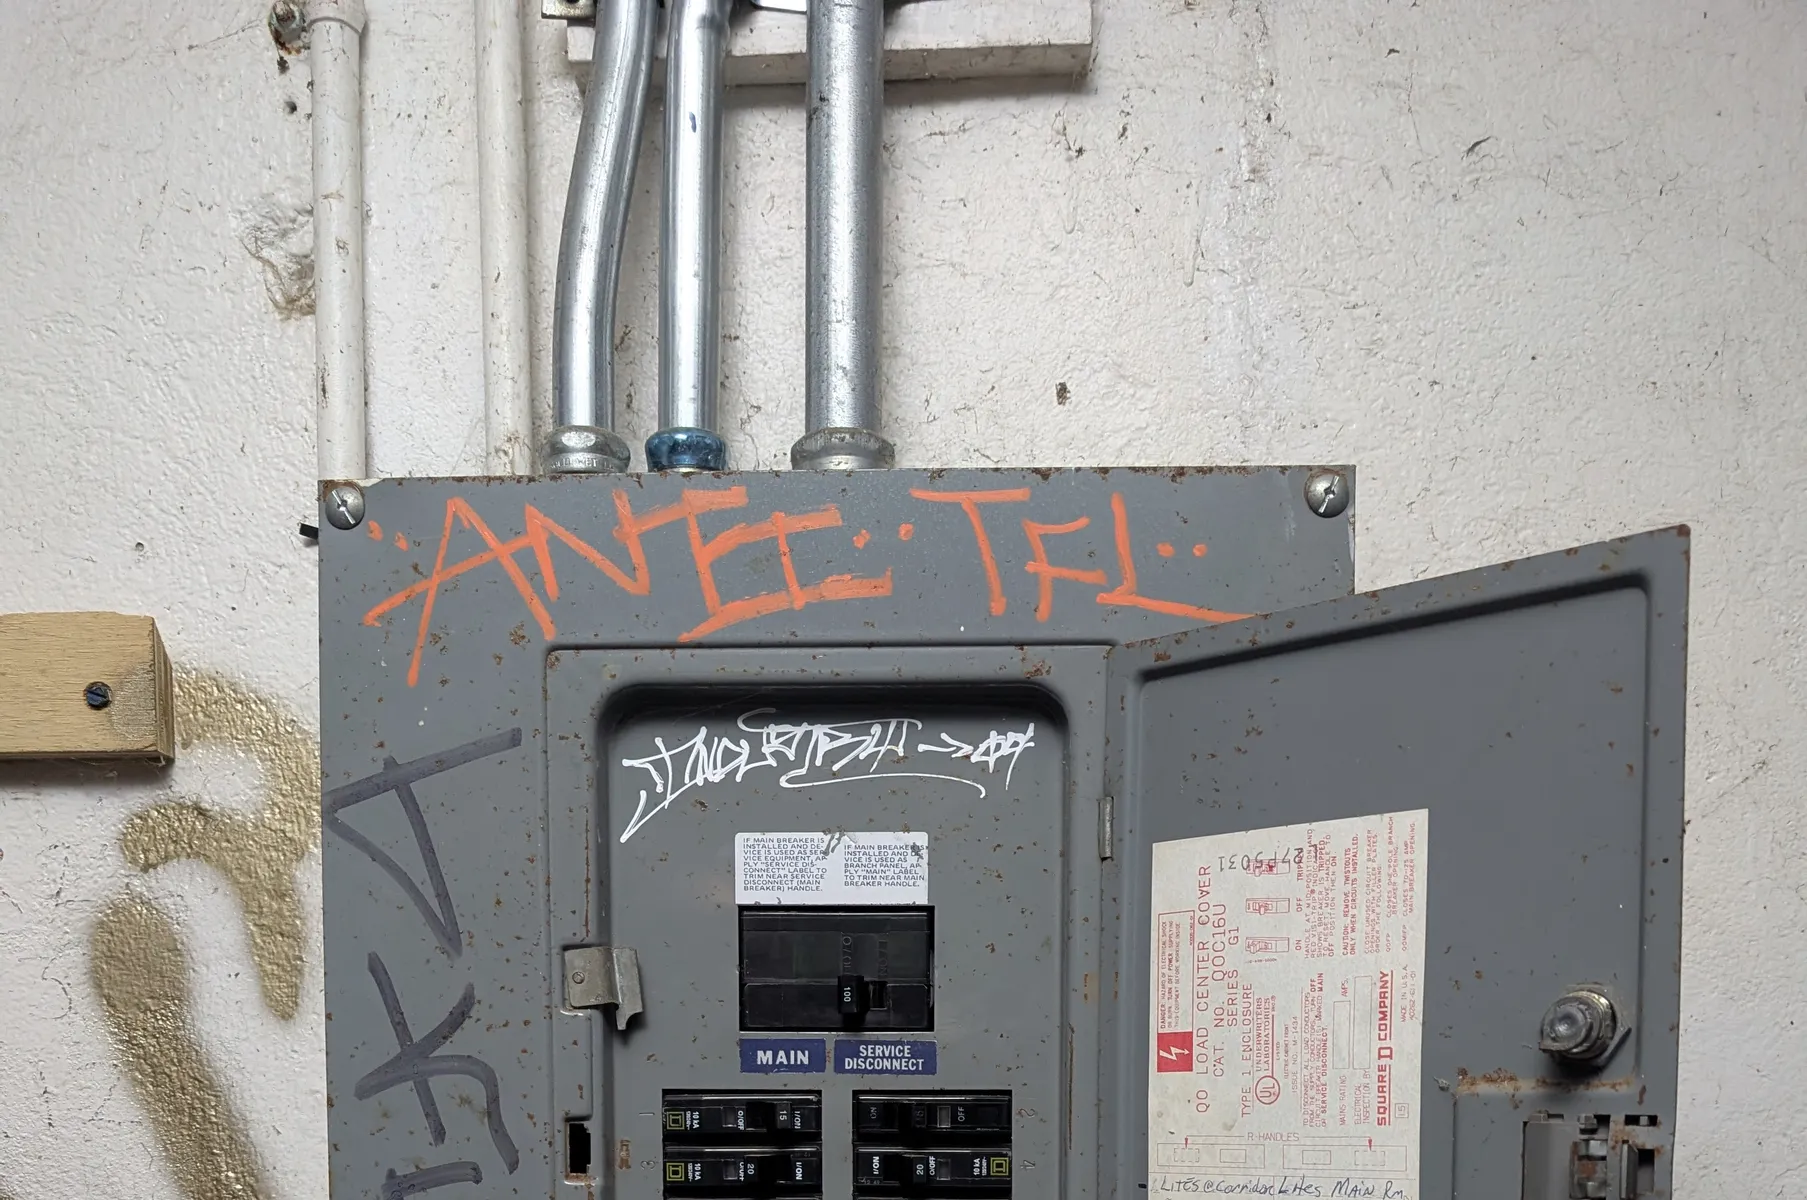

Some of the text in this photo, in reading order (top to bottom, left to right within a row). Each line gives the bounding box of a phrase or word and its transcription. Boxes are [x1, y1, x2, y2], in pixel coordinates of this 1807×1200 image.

[1228, 926, 1239, 1027] SERIES G1
[843, 987, 851, 1002] 100
[1196, 865, 1211, 1113] QO LOAD CENTER COVER
[1212, 904, 1227, 1077] CAT. NO. QOC16U
[1401, 992, 1407, 1000] IN
[1242, 983, 1252, 1061] ENCLOSURE
[1255, 997, 1263, 1072] UNDERWRITERS
[859, 1045, 911, 1057] SERVICE
[1377, 970, 1393, 1126] SQUARE D COMPANY
[757, 1050, 809, 1065] MAIN
[845, 1058, 924, 1070] DISCONNECT
[1363, 1069, 1370, 1079] BY
[1241, 1087, 1251, 1117] TYPE
[1354, 1083, 1362, 1125] ELECTRICAL
[779, 1110, 787, 1121] 15
[747, 1163, 754, 1175] 20
[916, 1164, 924, 1176] 20
[973, 1167, 980, 1176] 10
